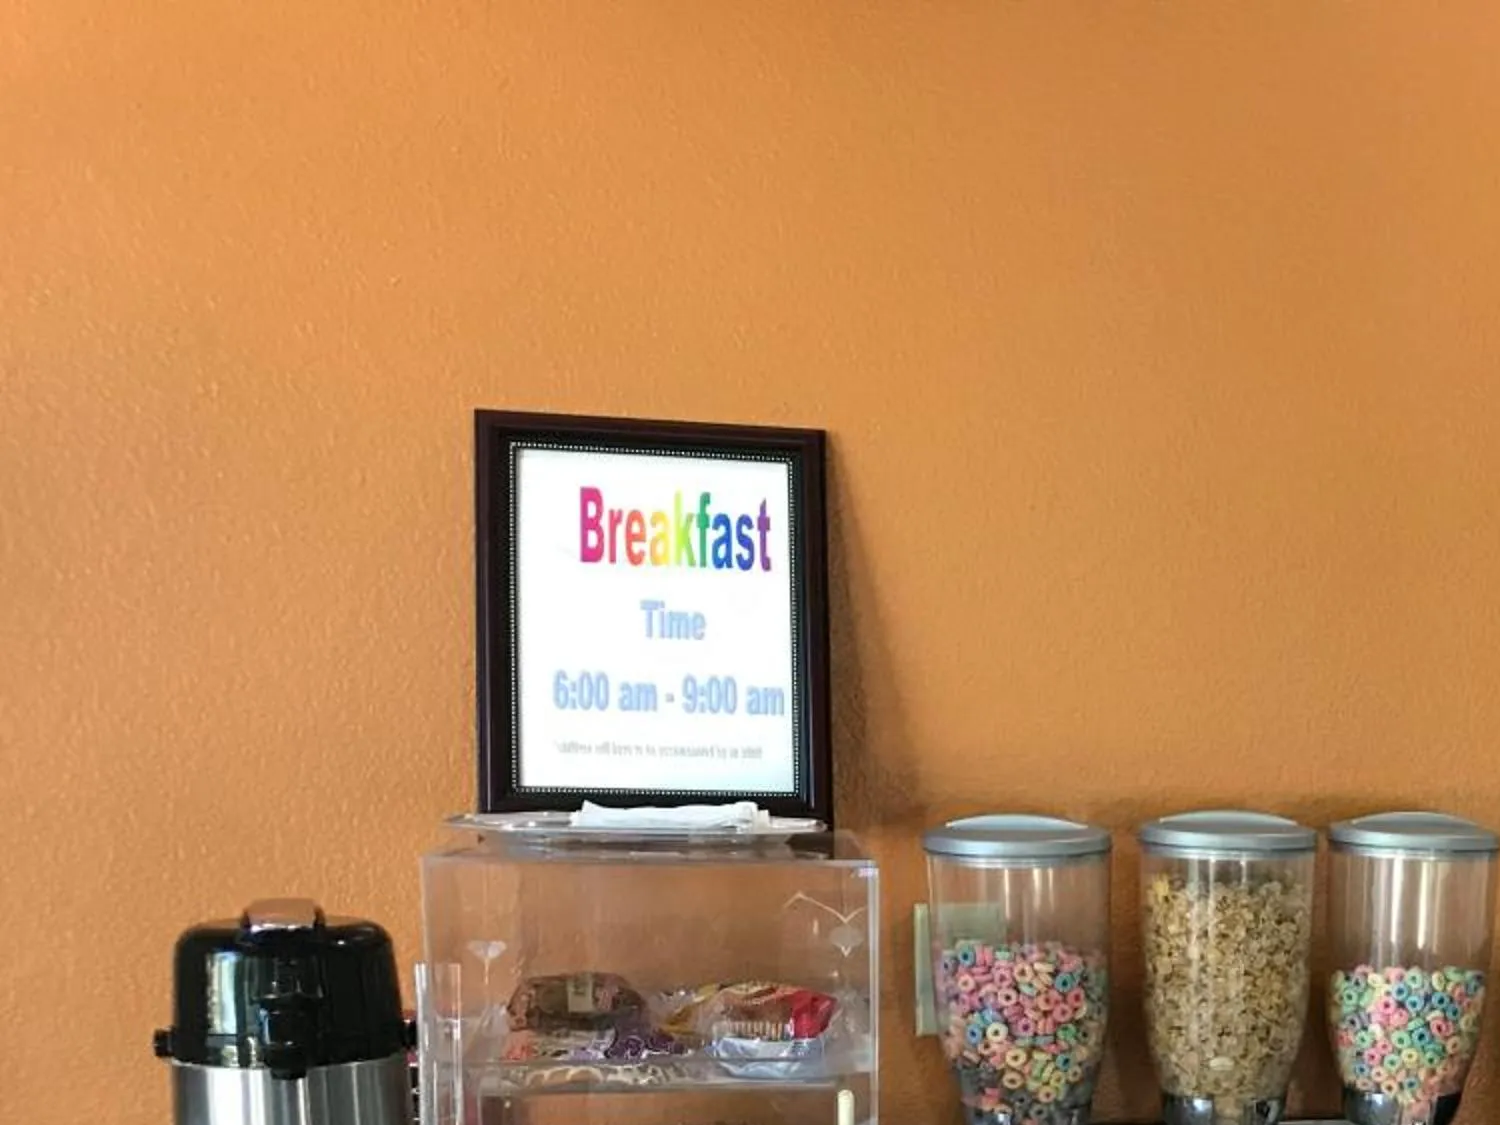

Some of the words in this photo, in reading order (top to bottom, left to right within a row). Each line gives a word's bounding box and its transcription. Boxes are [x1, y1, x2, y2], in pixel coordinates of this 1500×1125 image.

[579, 486, 772, 571] Breakfast
[640, 599, 706, 640] Time
[553, 669, 609, 711] 6:00
[618, 681, 658, 711] am
[681, 673, 737, 715] 9:00
[746, 685, 785, 716] am
